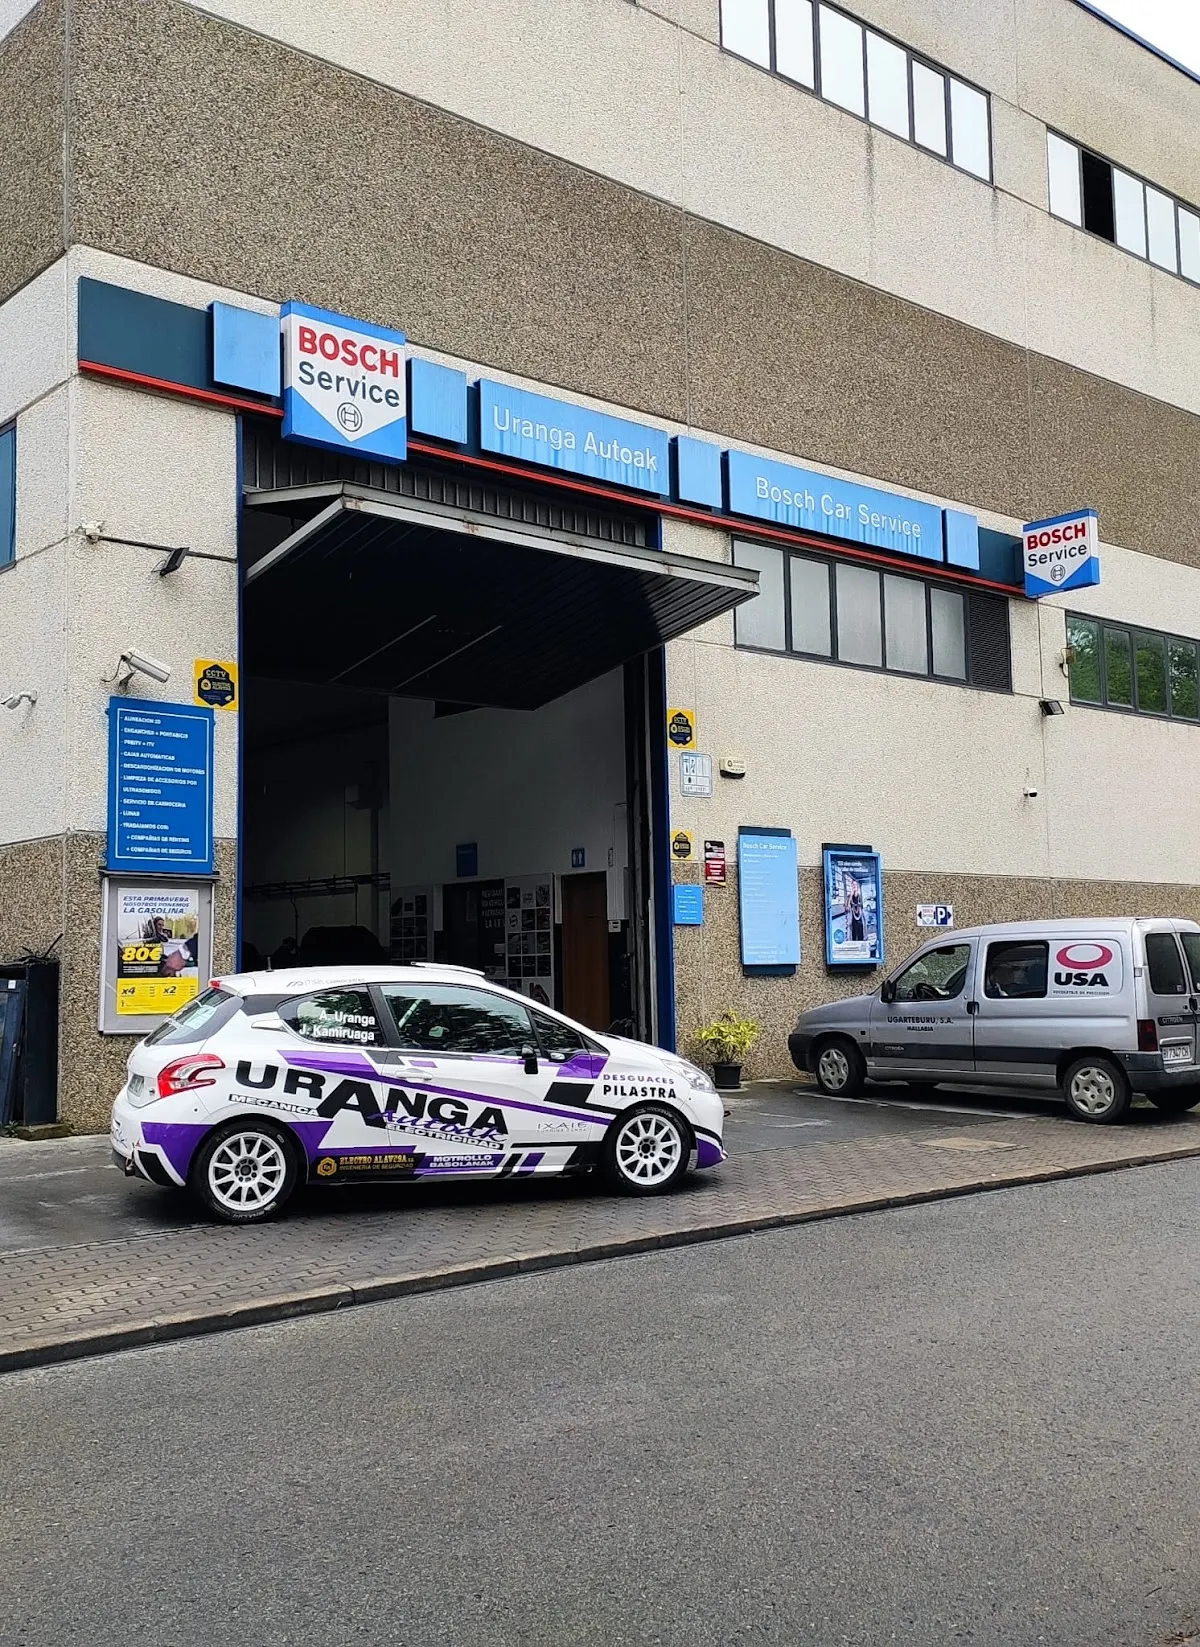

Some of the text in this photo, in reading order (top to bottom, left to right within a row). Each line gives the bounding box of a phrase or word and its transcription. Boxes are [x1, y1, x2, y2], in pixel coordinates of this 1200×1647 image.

[299, 325, 399, 378] BOSCH
[298, 361, 400, 408] Service
[492, 405, 658, 472] Uranga Autoak
[756, 476, 921, 538] Bosch Car Service
[1027, 522, 1086, 550] BOSCH
[1028, 544, 1087, 567] Service
[206, 670, 226, 678] CCTV
[937, 907, 946, 924] P
[122, 947, 163, 961] 80€
[1054, 972, 1110, 987] USA
[163, 985, 177, 994] x2
[319, 1009, 376, 1027] A. Uranga
[299, 1023, 375, 1042] J. Kamiruaga
[602, 1074, 675, 1085] DESGUACES
[235, 1060, 509, 1135] URANGA
[602, 1084, 677, 1099] PILASTRA
[230, 1095, 320, 1117] MECANICA
[385, 1124, 501, 1149] ELECTRICIDAD
[339, 1156, 372, 1165] ELECTRO
